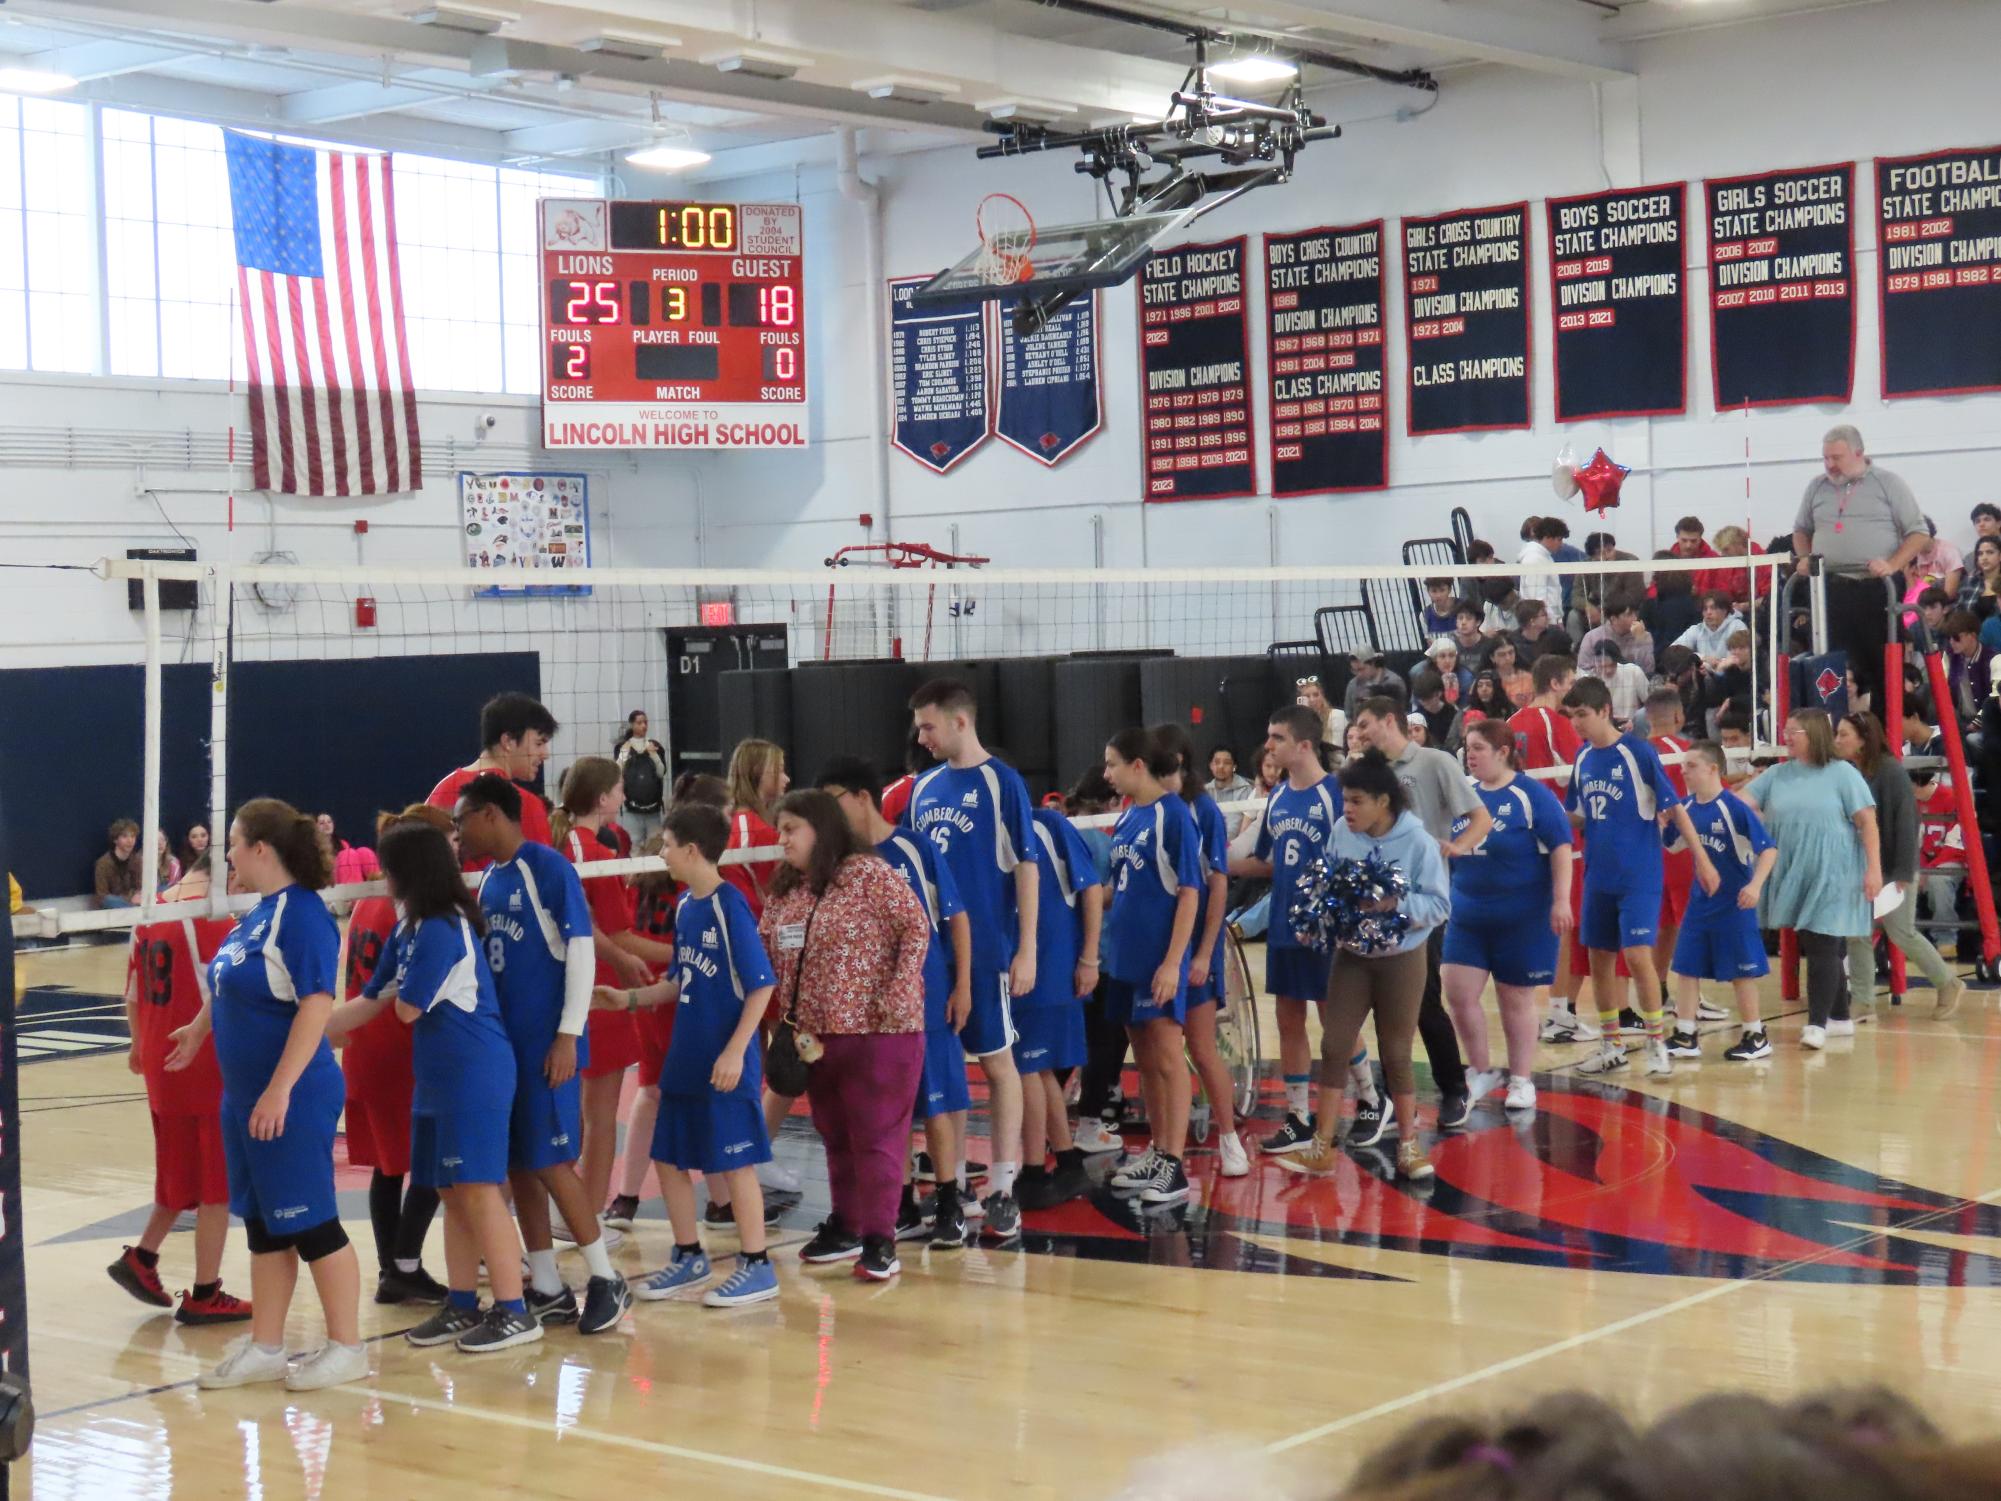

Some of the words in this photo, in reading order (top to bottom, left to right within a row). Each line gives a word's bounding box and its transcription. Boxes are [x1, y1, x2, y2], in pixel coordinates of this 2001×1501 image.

[1890, 159, 2001, 191] FOOTBAL
[1717, 186, 1766, 212] GIRLS
[1774, 176, 1842, 204] SOCCER
[1882, 192, 1933, 219] STATE
[745, 207, 795, 217] DONATED
[763, 217, 777, 226] BY
[1560, 205, 1599, 229] BOYS
[1606, 195, 1670, 222] SOCCER
[1714, 213, 1759, 238] STATE
[1765, 202, 1845, 232] CHAMPIONS
[659, 207, 732, 248] 1:00
[759, 226, 783, 235] 2004
[1407, 226, 1435, 248] GIRLS
[1440, 221, 1471, 244] CROSS
[1475, 215, 1521, 240] COUNTRY
[1555, 231, 1595, 256] STATE
[1601, 220, 1677, 249] CHAMPIONS
[1887, 225, 1916, 239] 1981
[1921, 221, 1950, 235] 2002
[747, 235, 794, 245] STUDENT
[748, 245, 794, 254] COUNCIL
[1269, 244, 1295, 264] BOYS
[1300, 239, 1330, 261] CROSS
[1335, 232, 1378, 257] COUNTRY
[1716, 245, 1742, 259] 2006
[1748, 241, 1775, 254] 2007
[558, 255, 613, 275] LIONS
[1145, 256, 1181, 279] FIELD
[1187, 248, 1236, 273] HOCKEY
[1409, 249, 1448, 273] STATE
[1453, 240, 1519, 267] CHAMPIONS
[1889, 242, 1943, 269] DIVISION
[653, 269, 698, 281] PERIOD
[732, 260, 791, 278] GUEST
[1271, 266, 1310, 289] STATE
[1314, 257, 1379, 284] CHAMPIONS
[1557, 264, 1581, 277] 2008
[1586, 259, 1610, 273] 2019
[1719, 260, 1769, 286] DIVISION
[1774, 252, 1842, 279] CHAMPIONS
[1143, 282, 1176, 303] STATE
[1182, 273, 1240, 299] CHAMPIONS
[1412, 278, 1436, 291] 1971
[1560, 280, 1606, 306] DIVISION
[1611, 273, 1676, 299] CHAMPIONS
[1889, 277, 1919, 290] 1979
[1922, 273, 1951, 287] 1981
[1956, 270, 1987, 283] 1982
[567, 282, 619, 323] 25
[668, 288, 685, 320] 3
[760, 285, 794, 325] 18
[1414, 294, 1456, 318] DIVISION
[1460, 287, 1519, 312] CHAMPIONS
[1718, 293, 1745, 306] 2007
[1749, 289, 1775, 302] 2010
[1781, 285, 1808, 298] 2011
[1815, 283, 1845, 295] 2013
[1145, 312, 1166, 322] 1971
[1194, 304, 1215, 316] 2001
[1218, 300, 1240, 312] 2020
[1274, 310, 1316, 333] DIVISION
[1321, 304, 1377, 328] CHAMPIONS
[1560, 315, 1584, 327] 2013
[1589, 311, 1612, 324] 2021
[551, 330, 591, 343] FOULS
[633, 331, 679, 344] PLAYER
[688, 331, 720, 344] FOUL
[760, 332, 799, 345] FOULS
[1146, 331, 1168, 343] 2023
[1329, 334, 1353, 346] 1970
[1358, 331, 1380, 343] 1971
[1413, 324, 1440, 337] 1972
[567, 346, 585, 377] 2
[776, 347, 794, 379] 0
[1413, 363, 1455, 386] CLASS
[1460, 356, 1524, 380] CHAMPIONS
[1149, 369, 1185, 390] DIVISION
[1190, 362, 1240, 385] CHAMPIONS
[1275, 377, 1312, 400] CLASS
[1317, 370, 1381, 394] CHAMPIONS
[551, 385, 593, 399] SCORE
[656, 386, 700, 400] MATCH
[761, 387, 801, 400] SCORE
[1173, 395, 1194, 406] 1977
[639, 410, 699, 420] WELCOME
[702, 410, 719, 420] TO
[1329, 400, 1353, 411] 1970
[1359, 397, 1379, 409] 1971
[549, 423, 647, 446] LINCOLN
[654, 423, 709, 445] HIGH
[716, 423, 805, 445] SCHOOL
[1359, 418, 1380, 429] 2004
[1225, 451, 1247, 462] 2020
[1277, 447, 1300, 458] 2021
[1152, 480, 1173, 491] 2023
[680, 655, 700, 674] D1
[915, 806, 974, 833] CUMBERLAND
[1589, 796, 1607, 820] 12
[1272, 817, 1322, 843] CUMBERLAND
[1284, 838, 1300, 866] 6
[489, 937, 505, 973] 8
[140, 939, 173, 1007] 19
